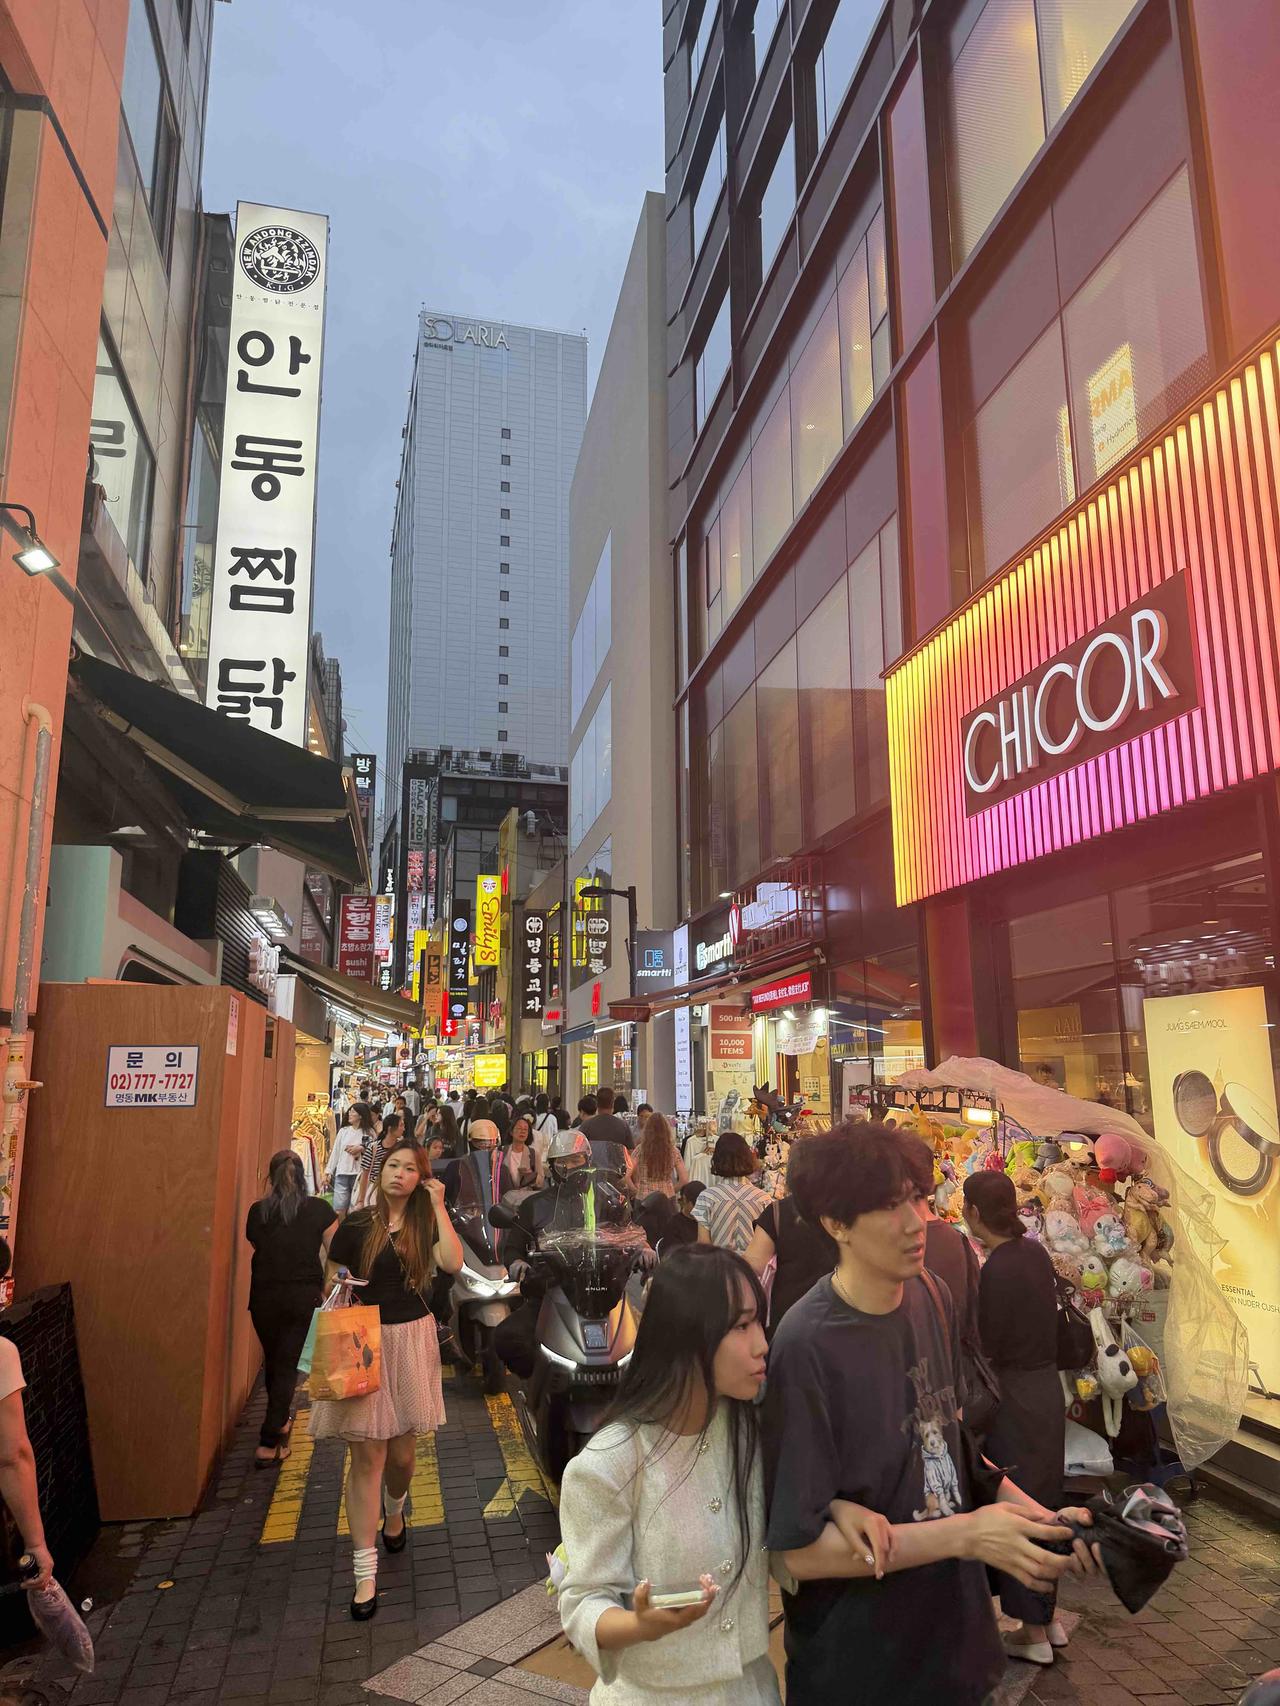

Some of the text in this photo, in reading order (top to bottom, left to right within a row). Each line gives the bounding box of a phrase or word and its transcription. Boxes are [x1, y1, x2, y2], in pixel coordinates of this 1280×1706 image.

[243, 228, 316, 279] NEW ANDONG ZZIMDAK
[424, 317, 510, 351] SOLARIA
[217, 330, 311, 730] 안동찜닭
[964, 608, 1180, 793] CHICOR
[345, 957, 368, 967] sushi
[347, 969, 366, 977] tuna
[526, 938, 542, 1012] 명동교자
[636, 968, 672, 978] smartti
[719, 1039, 745, 1047] 10,000
[720, 1047, 744, 1055] ITEMS
[115, 1092, 188, 1103] 명동MK부동산
[1221, 1284, 1256, 1298] ESSENTIAL
